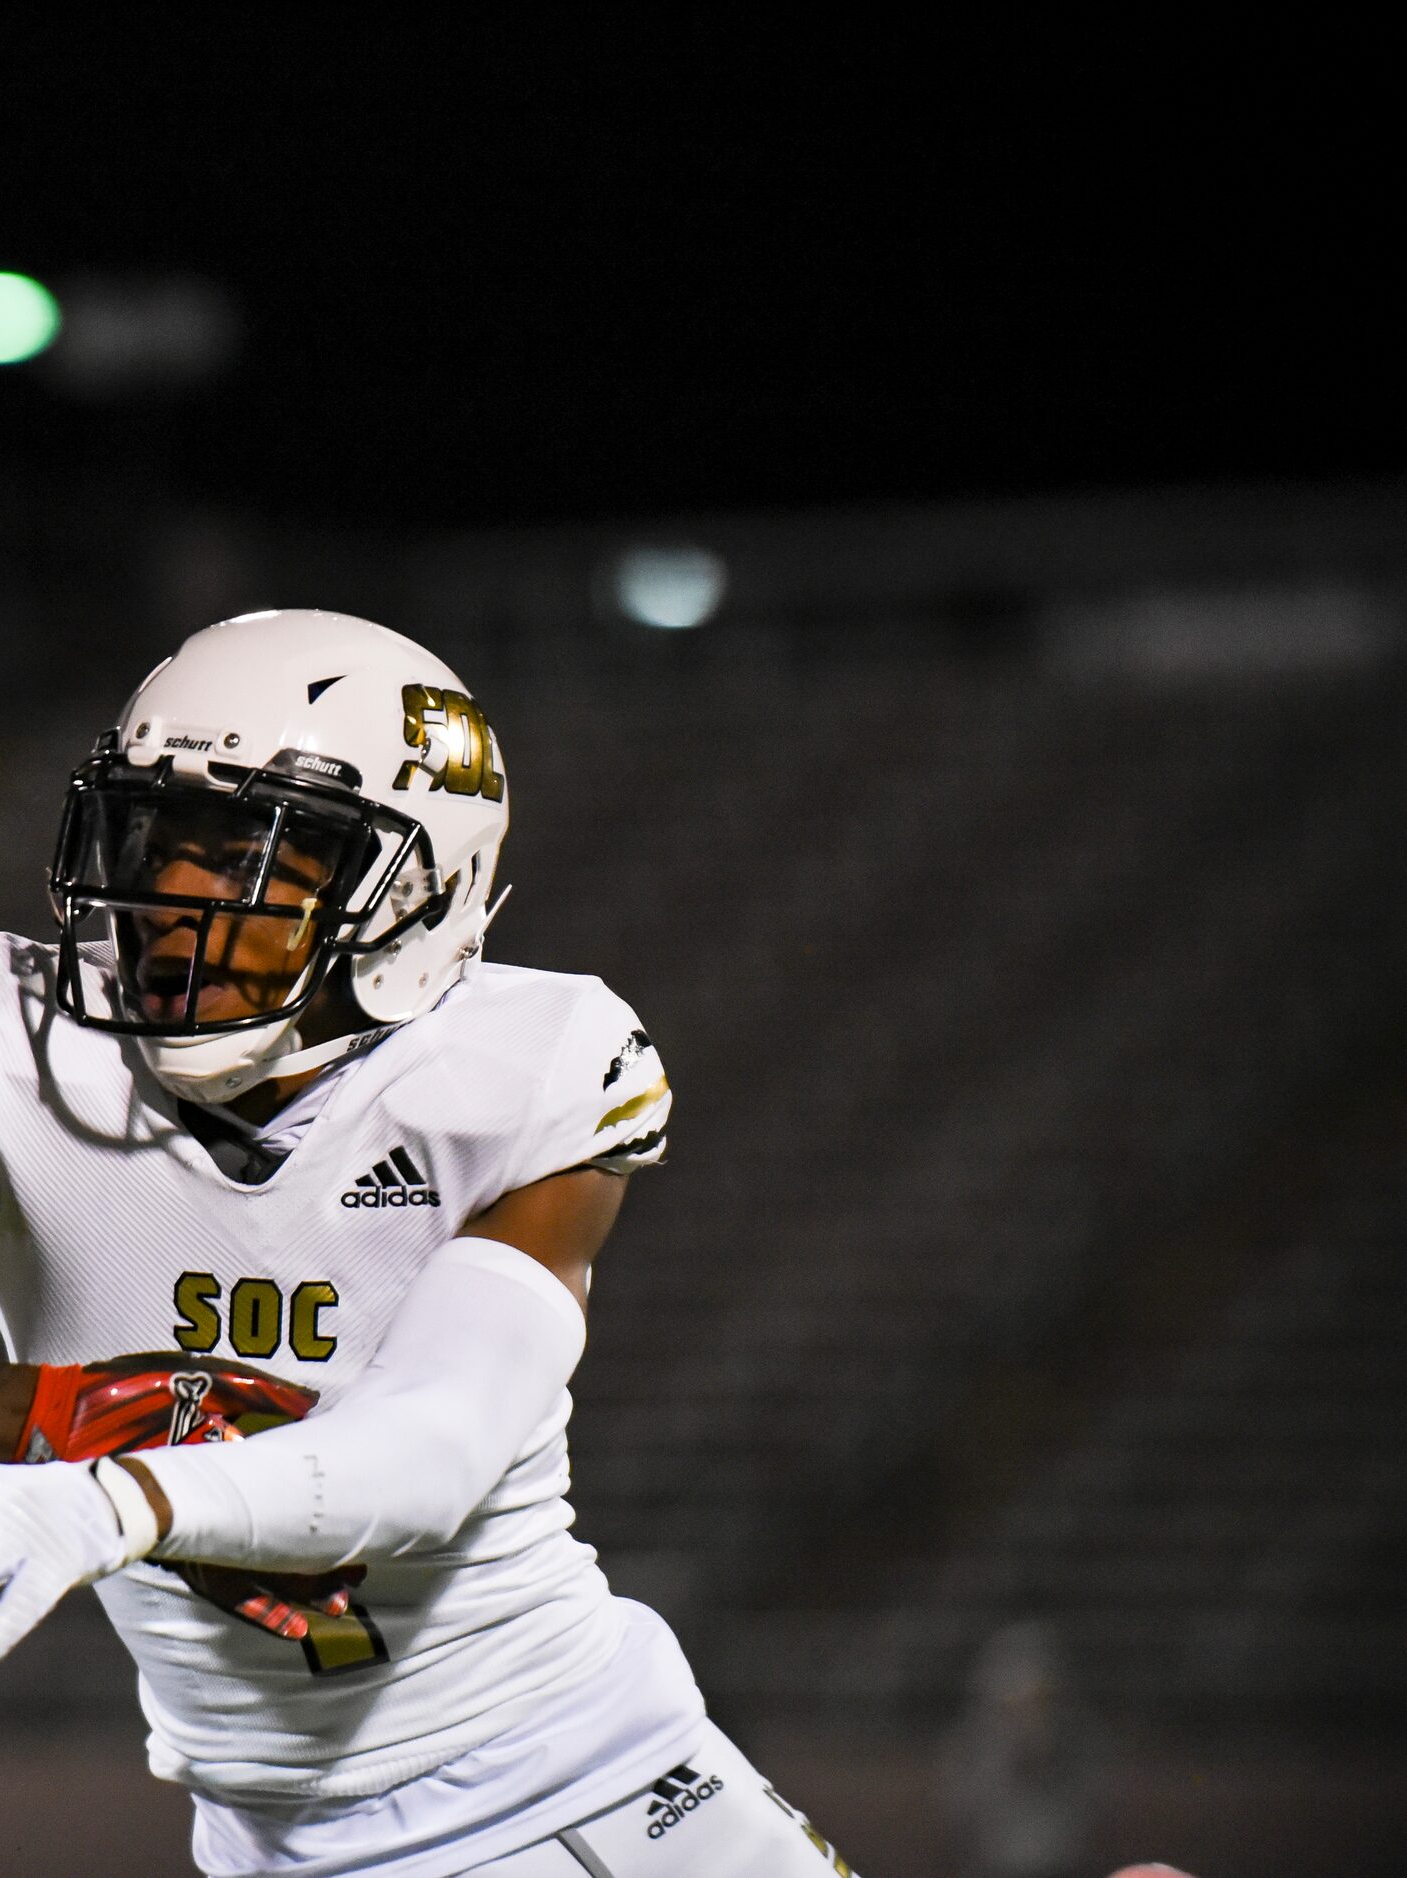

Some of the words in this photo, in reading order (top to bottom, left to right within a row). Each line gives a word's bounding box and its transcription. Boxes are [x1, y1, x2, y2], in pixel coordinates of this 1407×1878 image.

[164, 734, 213, 752] schutt
[295, 754, 342, 777] schutt
[340, 1185, 441, 1209] adidas
[173, 1271, 340, 1362] SOC
[646, 1774, 725, 1840] adidas
